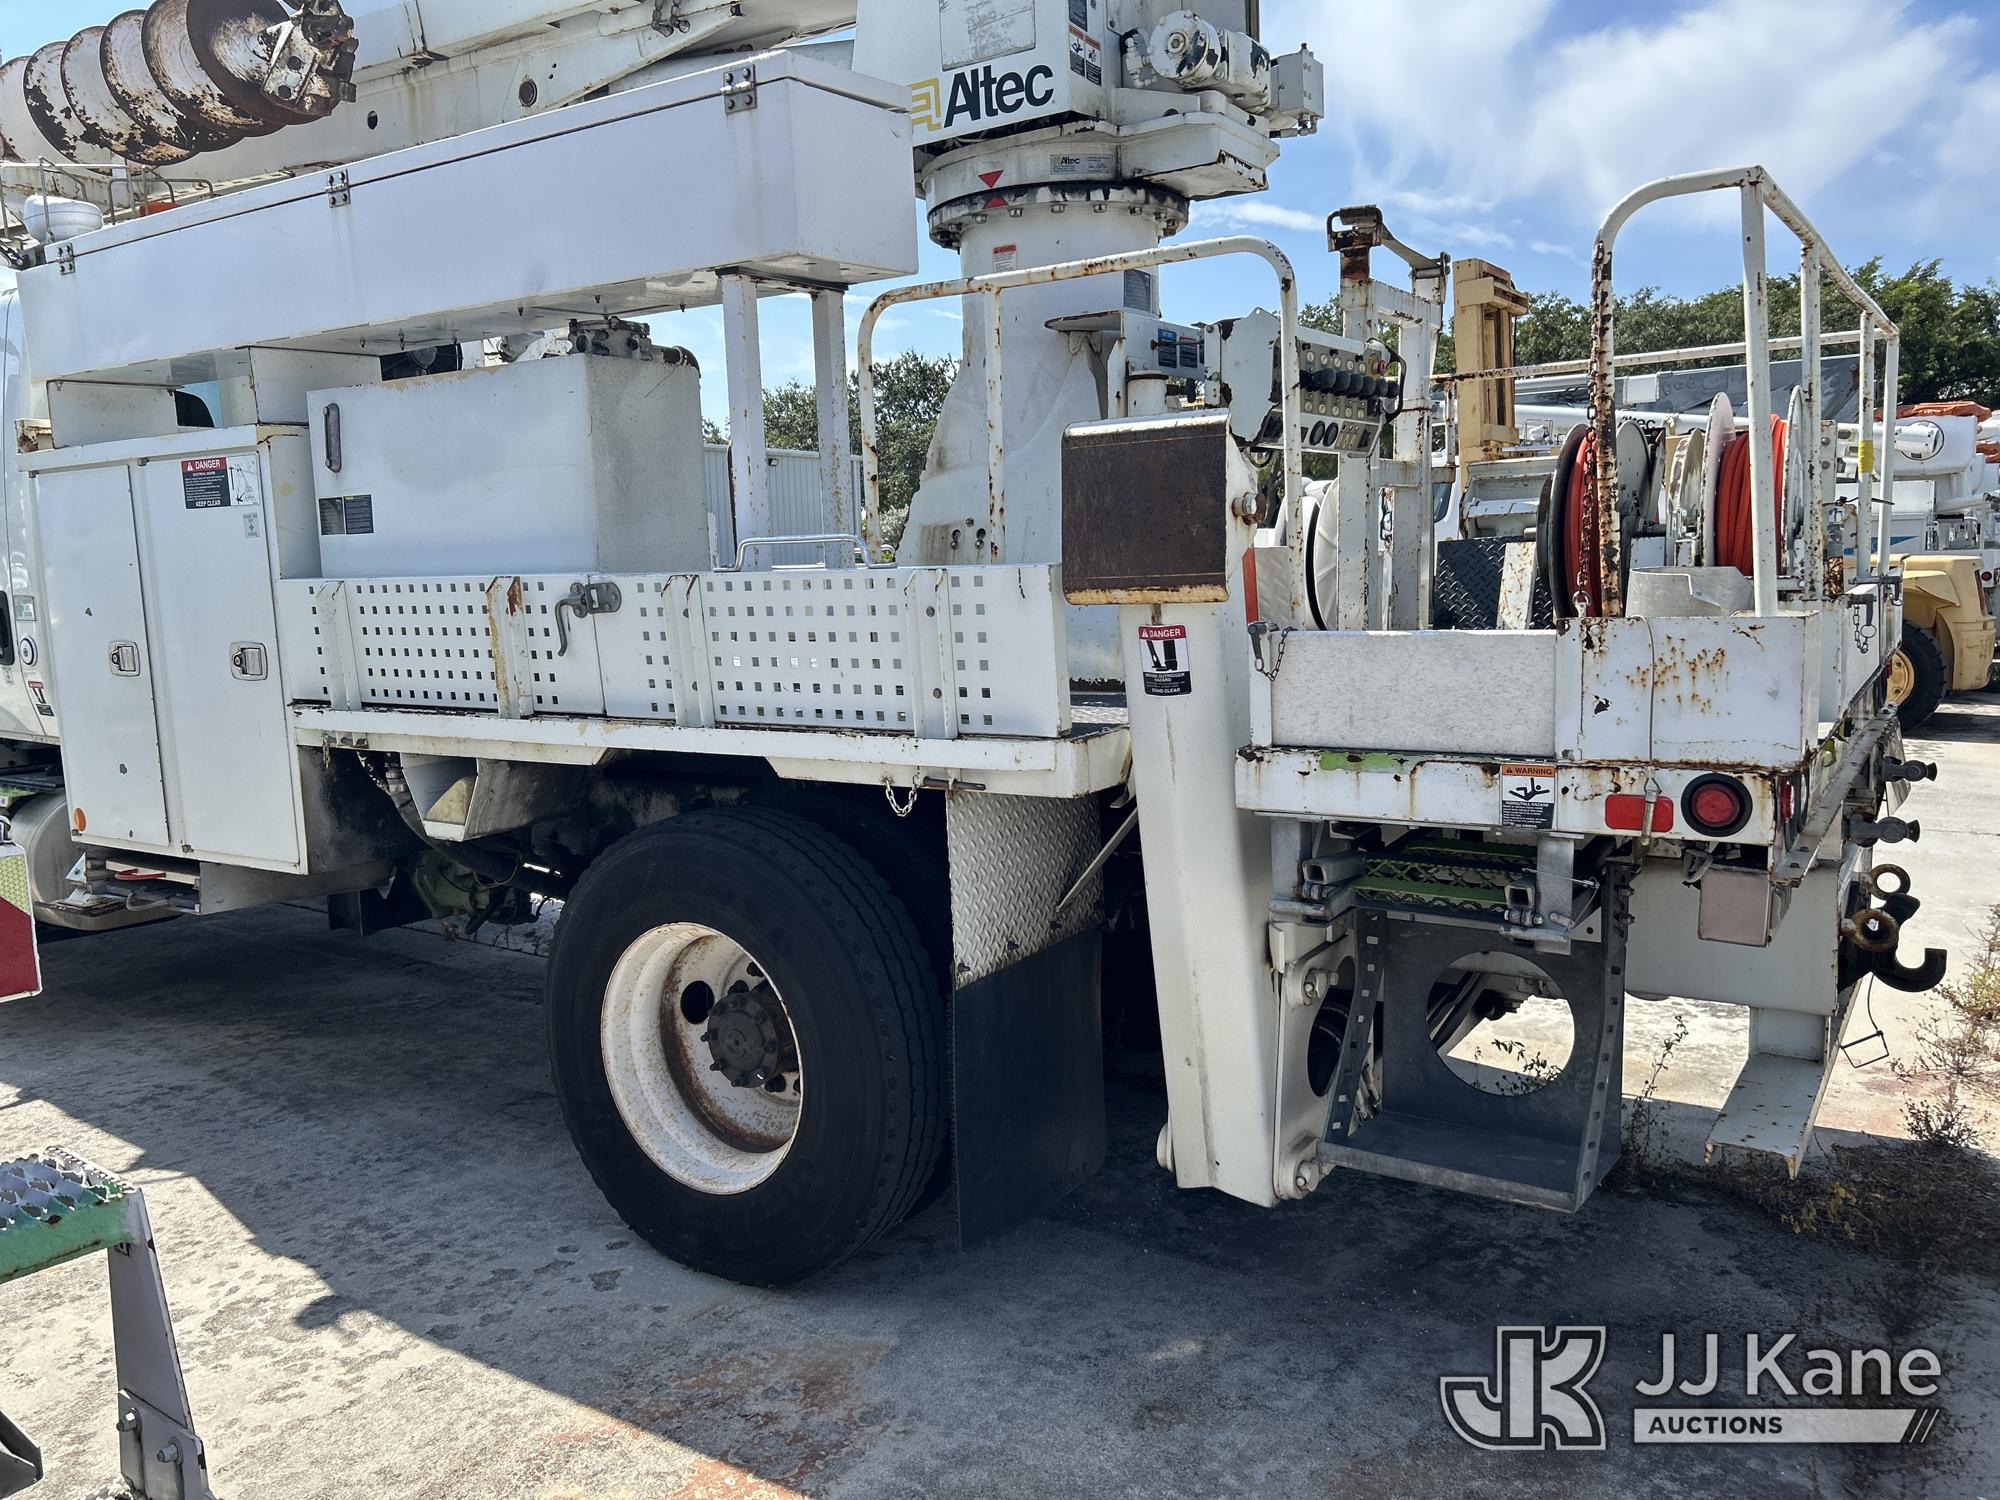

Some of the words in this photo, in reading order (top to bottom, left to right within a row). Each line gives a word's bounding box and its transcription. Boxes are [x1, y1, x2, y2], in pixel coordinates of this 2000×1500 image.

[943, 64, 1054, 128] Altec
[1060, 156, 1081, 165] Altec
[195, 459, 221, 470] DANGER
[207, 499, 221, 507] CLEAR
[1149, 628, 1181, 638] DANGER
[1514, 767, 1552, 775] WARNING
